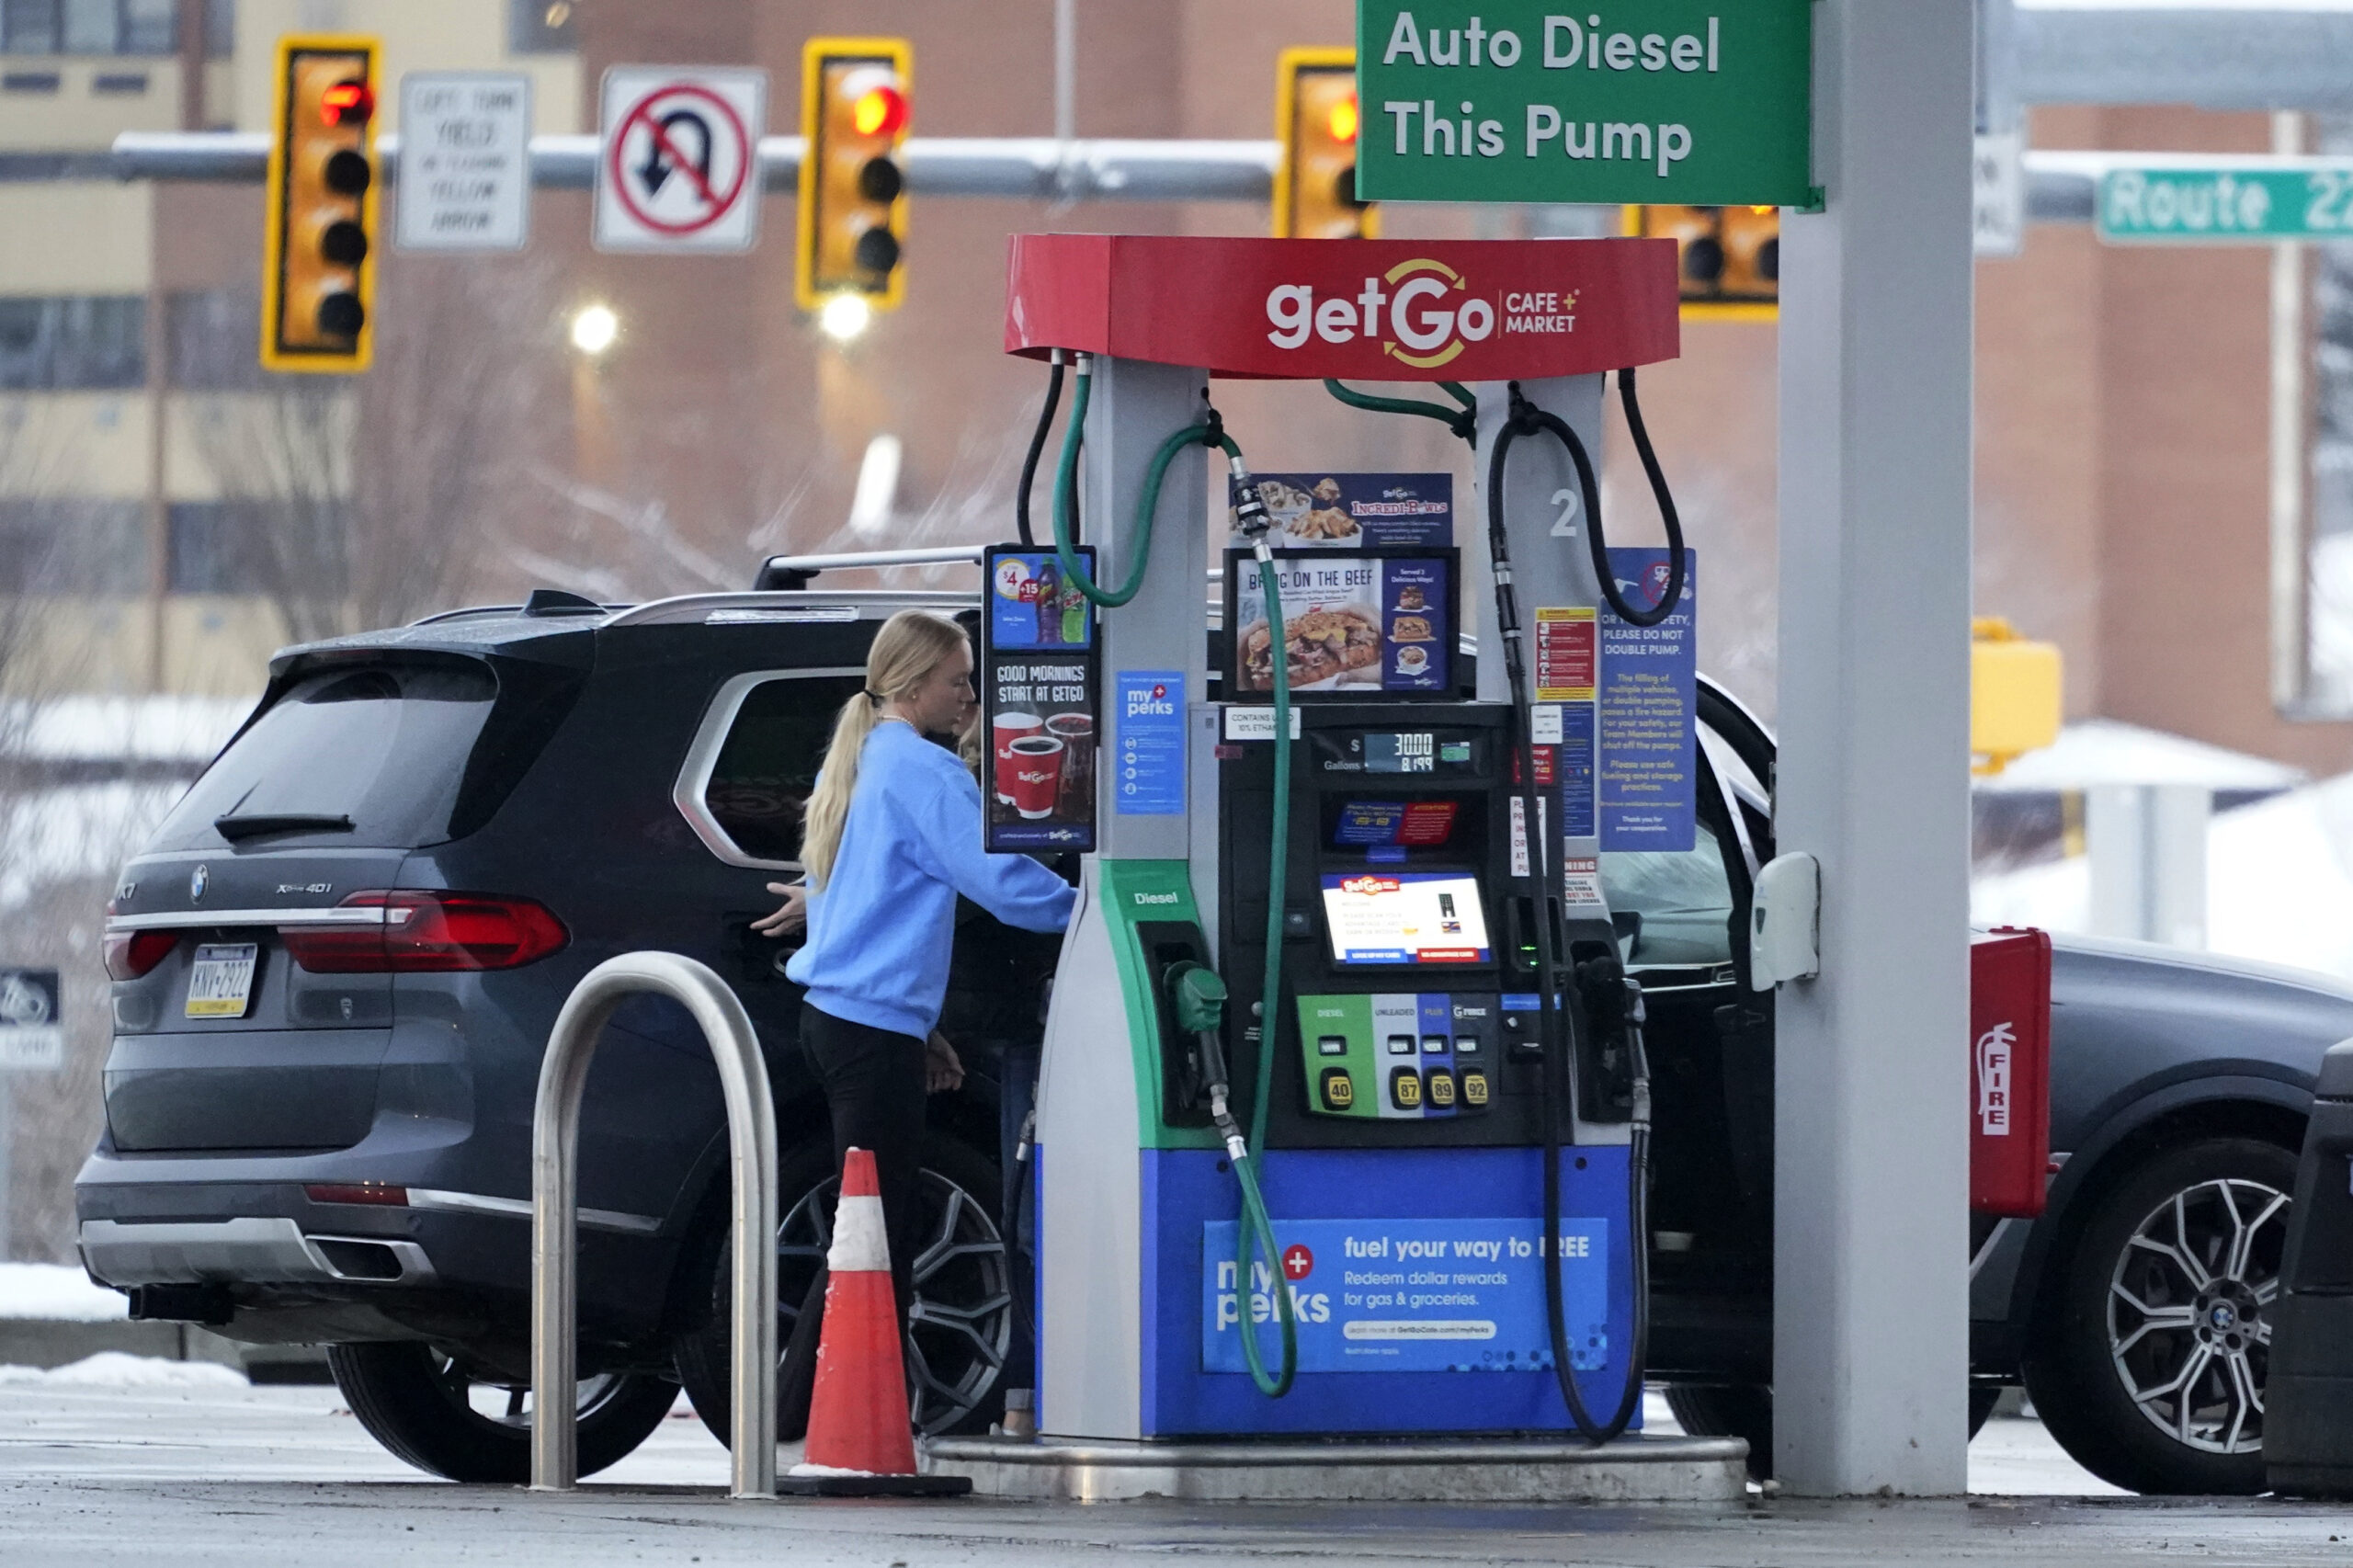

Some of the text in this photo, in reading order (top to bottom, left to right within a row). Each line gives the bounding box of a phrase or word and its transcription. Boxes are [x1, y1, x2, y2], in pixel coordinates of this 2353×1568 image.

[1383, 12, 1719, 72] Auto Diesel
[1383, 100, 1693, 177] This Pump
[2111, 173, 2270, 229] Route
[1266, 277, 1495, 350] getGo
[1506, 316, 1575, 333] MARKET
[1550, 488, 1578, 537] 2
[1249, 569, 1373, 590] BRG ON THE BEEF
[1601, 614, 1617, 624] OR
[1603, 630, 1684, 641] PLEASE DO NOT
[1605, 644, 1682, 655] DOUBLE PUMP.
[997, 665, 1085, 682] GOOD MORNINGS
[1618, 674, 1670, 685] The filling of
[998, 686, 1085, 703] START AT GETGO
[1127, 690, 1153, 703] my
[1127, 702, 1174, 718] perks
[1634, 708, 1651, 716] fire
[1652, 708, 1684, 716] hazard.
[1232, 713, 1270, 722] CONTAINS
[1618, 721, 1636, 729] your
[1638, 720, 1667, 728] safety,
[1603, 730, 1683, 738] Team Members will
[1602, 741, 1683, 752] shut off the pumps.
[1324, 760, 1361, 770] Gallons
[1609, 760, 1639, 768] Please
[1656, 760, 1675, 768] safe
[1651, 772, 1684, 782] storage
[1514, 801, 1541, 809] PLE
[1564, 860, 1596, 870] NING
[1343, 880, 1383, 892] getGo
[1134, 892, 1178, 904] Diesel
[1317, 1009, 1344, 1017] DIESEL
[1375, 1007, 1415, 1017] UNLEADED
[1332, 1083, 1349, 1096] 40
[1401, 1084, 1417, 1097] 87
[1434, 1083, 1452, 1097] 89
[1467, 1083, 1485, 1096] 92
[1988, 1053, 2006, 1126] FIRE
[1344, 1236, 1388, 1257] fuel
[1395, 1240, 1448, 1263] your
[1453, 1240, 1502, 1263] way
[1508, 1236, 1532, 1258] to
[1344, 1271, 1507, 1285] Redeem dollar rewards
[1344, 1291, 1480, 1310] for gas & groceries.
[1216, 1285, 1331, 1332] perks
